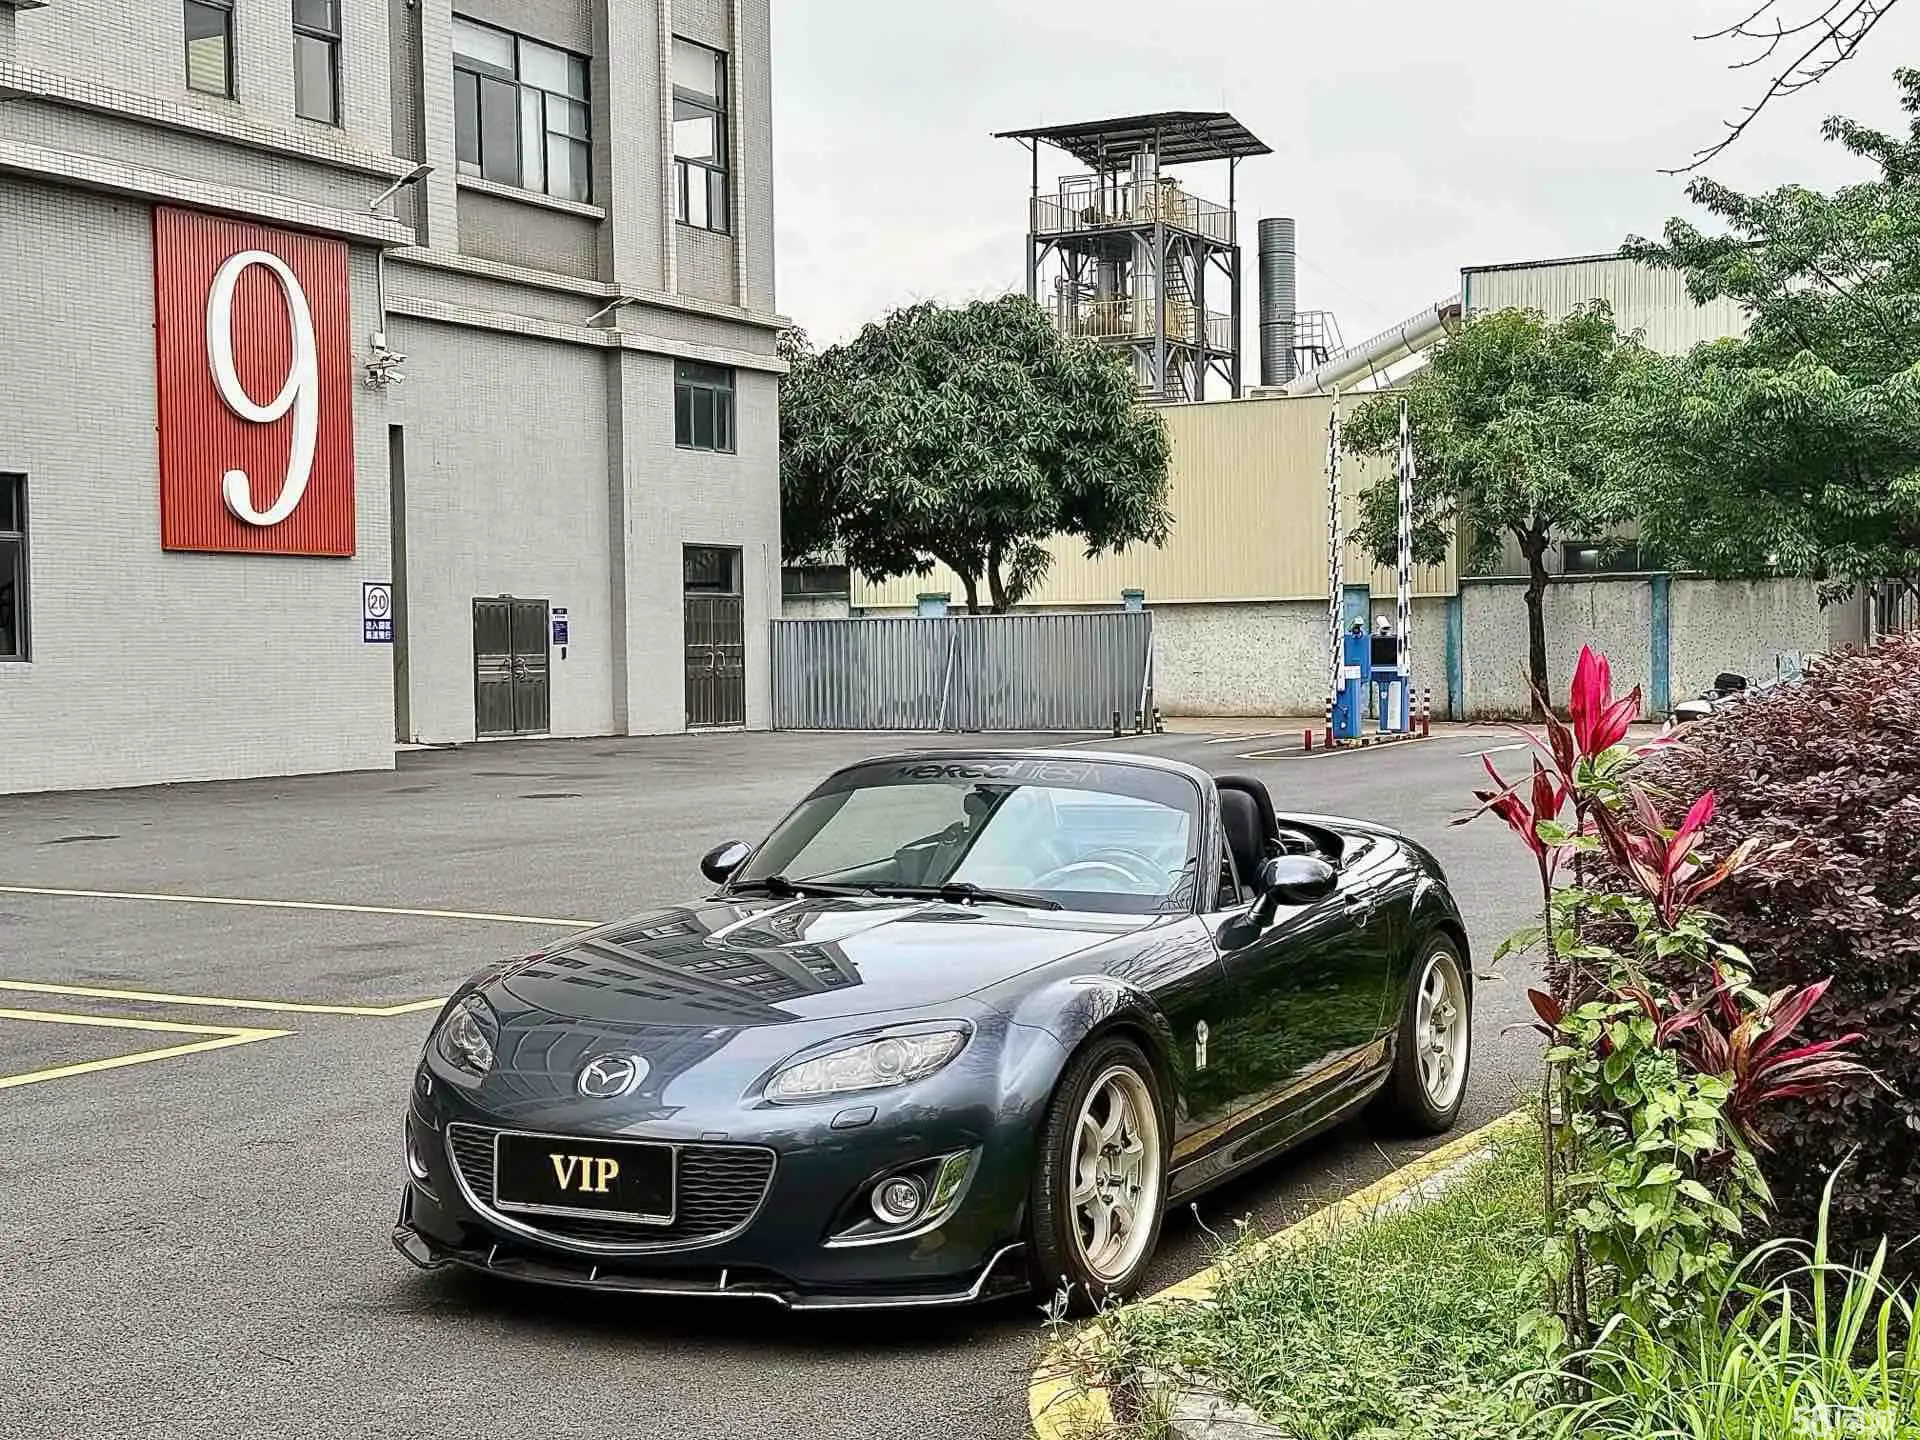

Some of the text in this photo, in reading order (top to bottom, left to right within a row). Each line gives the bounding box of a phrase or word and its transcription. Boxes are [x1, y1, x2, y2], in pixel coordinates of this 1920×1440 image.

[206, 250, 319, 527] 9
[371, 594, 386, 610] 20
[549, 1153, 620, 1193] VIP
